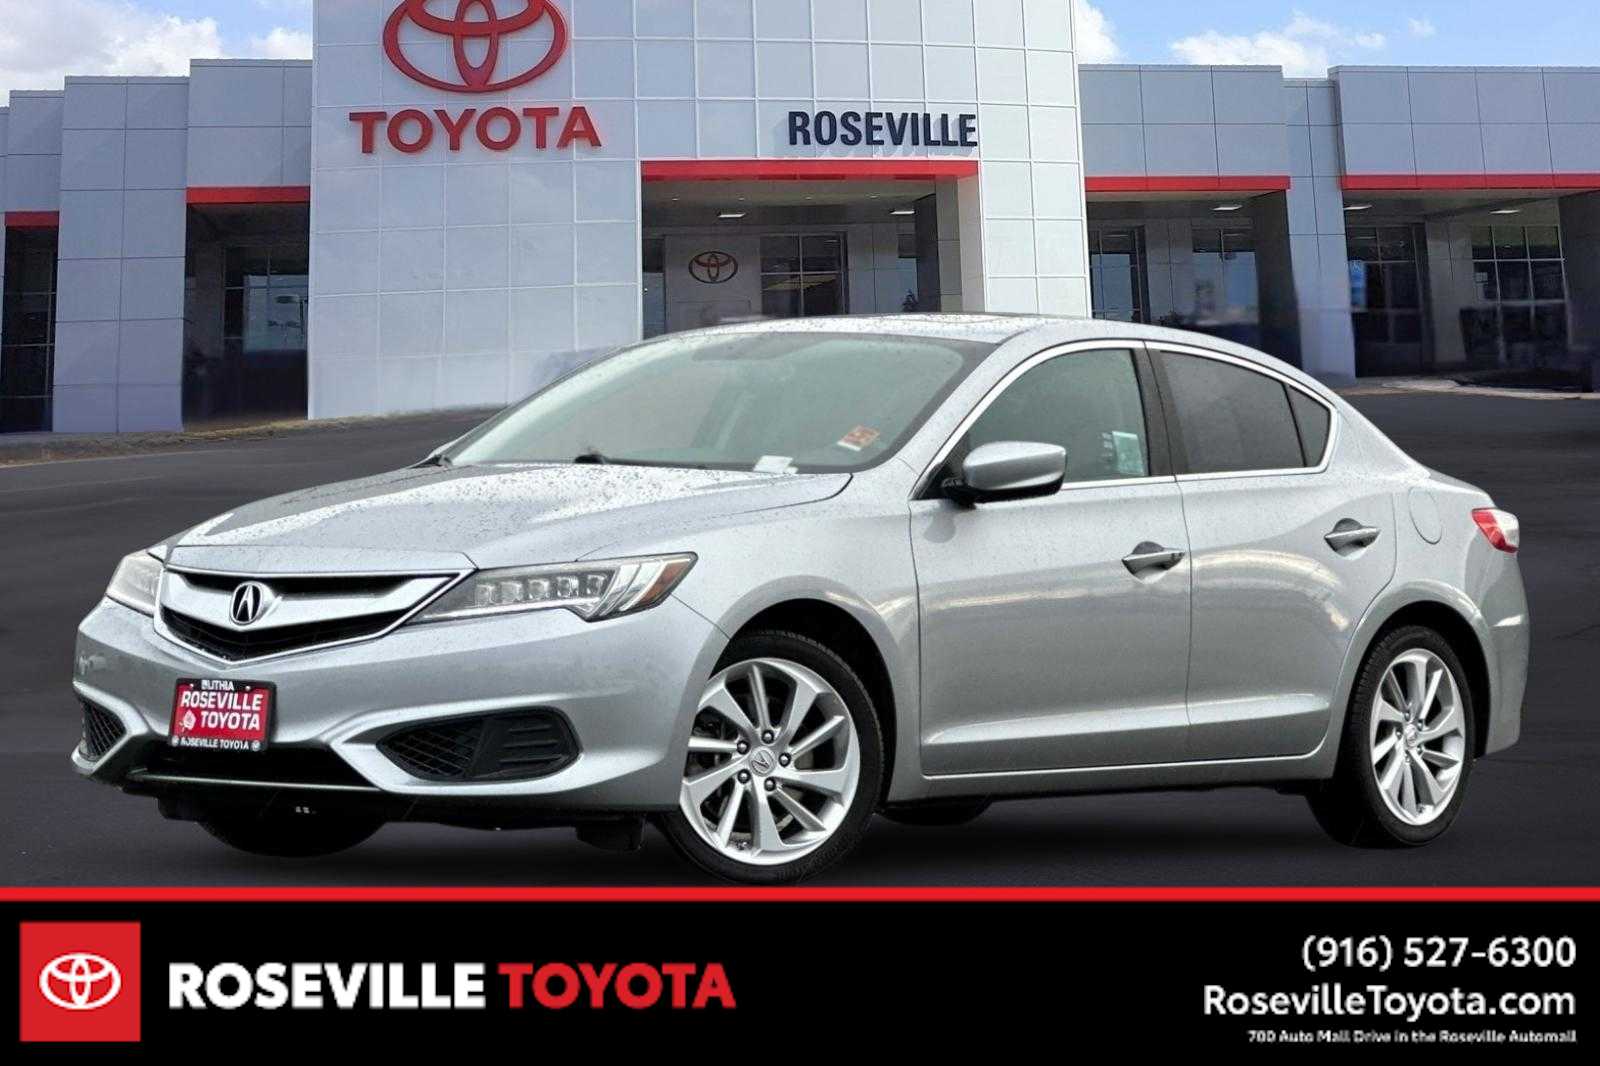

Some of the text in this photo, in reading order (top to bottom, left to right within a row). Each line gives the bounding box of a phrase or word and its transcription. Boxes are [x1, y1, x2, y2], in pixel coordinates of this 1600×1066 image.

[349, 106, 602, 153] TOYOTA
[788, 110, 978, 147] ROSEVILLE
[208, 680, 235, 691] LITHIA
[180, 690, 263, 711] ROSEVILLE
[201, 711, 260, 731] TOYOTA
[220, 739, 249, 750] TOYOTA
